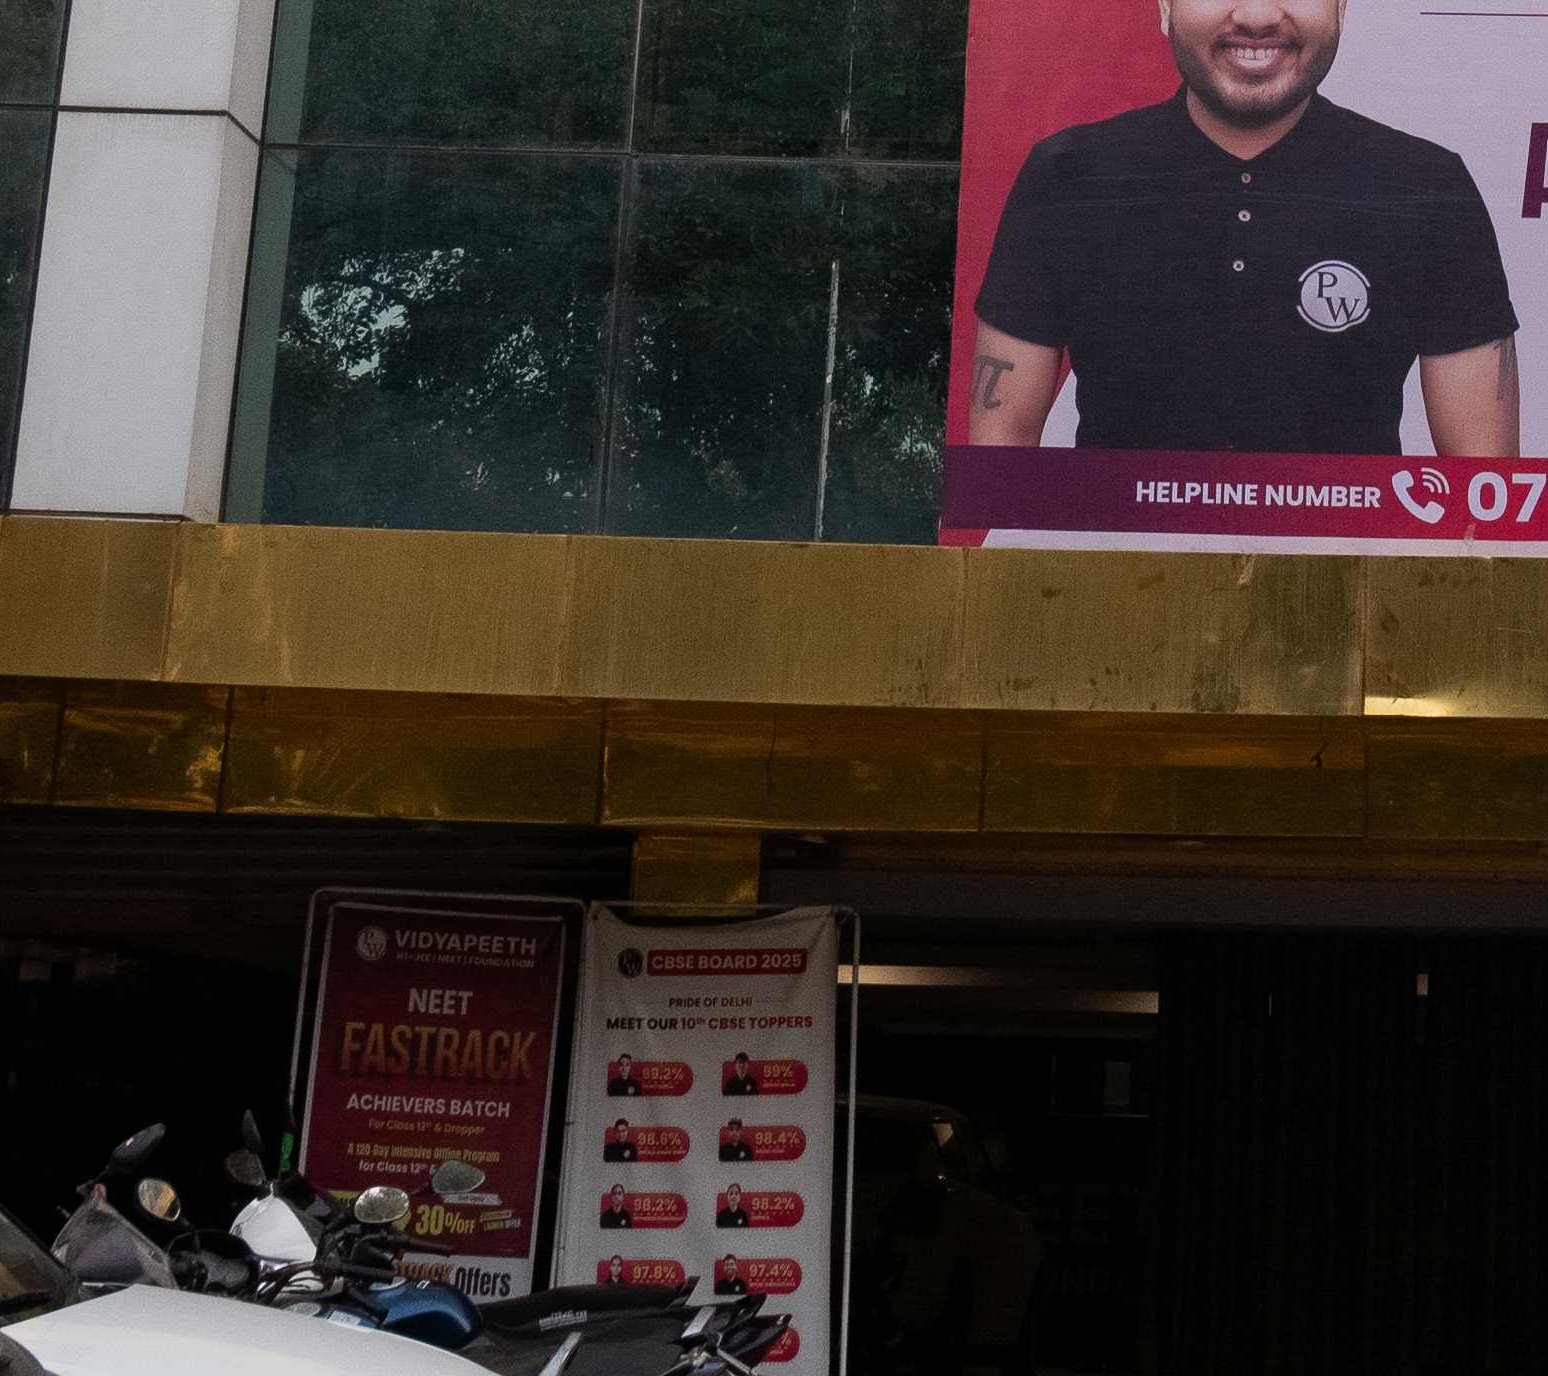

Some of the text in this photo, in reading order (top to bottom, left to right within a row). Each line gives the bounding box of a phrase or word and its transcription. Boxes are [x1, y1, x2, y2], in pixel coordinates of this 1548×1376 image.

[1134, 478, 1261, 506] HELPLINE
[1264, 481, 1383, 509] NUMBER
[395, 929, 537, 956] VIDYAPEETH
[650, 955, 694, 970] CBSE
[697, 954, 758, 970] BOARD
[759, 952, 802, 969] 2025
[407, 987, 474, 1015] NEET
[668, 997, 753, 1008] PRIDE OF DELHI
[606, 1016, 643, 1030] MEET
[646, 1017, 678, 1030] OUR
[707, 1016, 746, 1030] CBSE
[749, 1015, 813, 1029] TOPPERS
[340, 1021, 538, 1080] FASTRACK
[346, 1093, 511, 1118] ACHIEVERS BATCH
[454, 1266, 511, 1297] Offers
